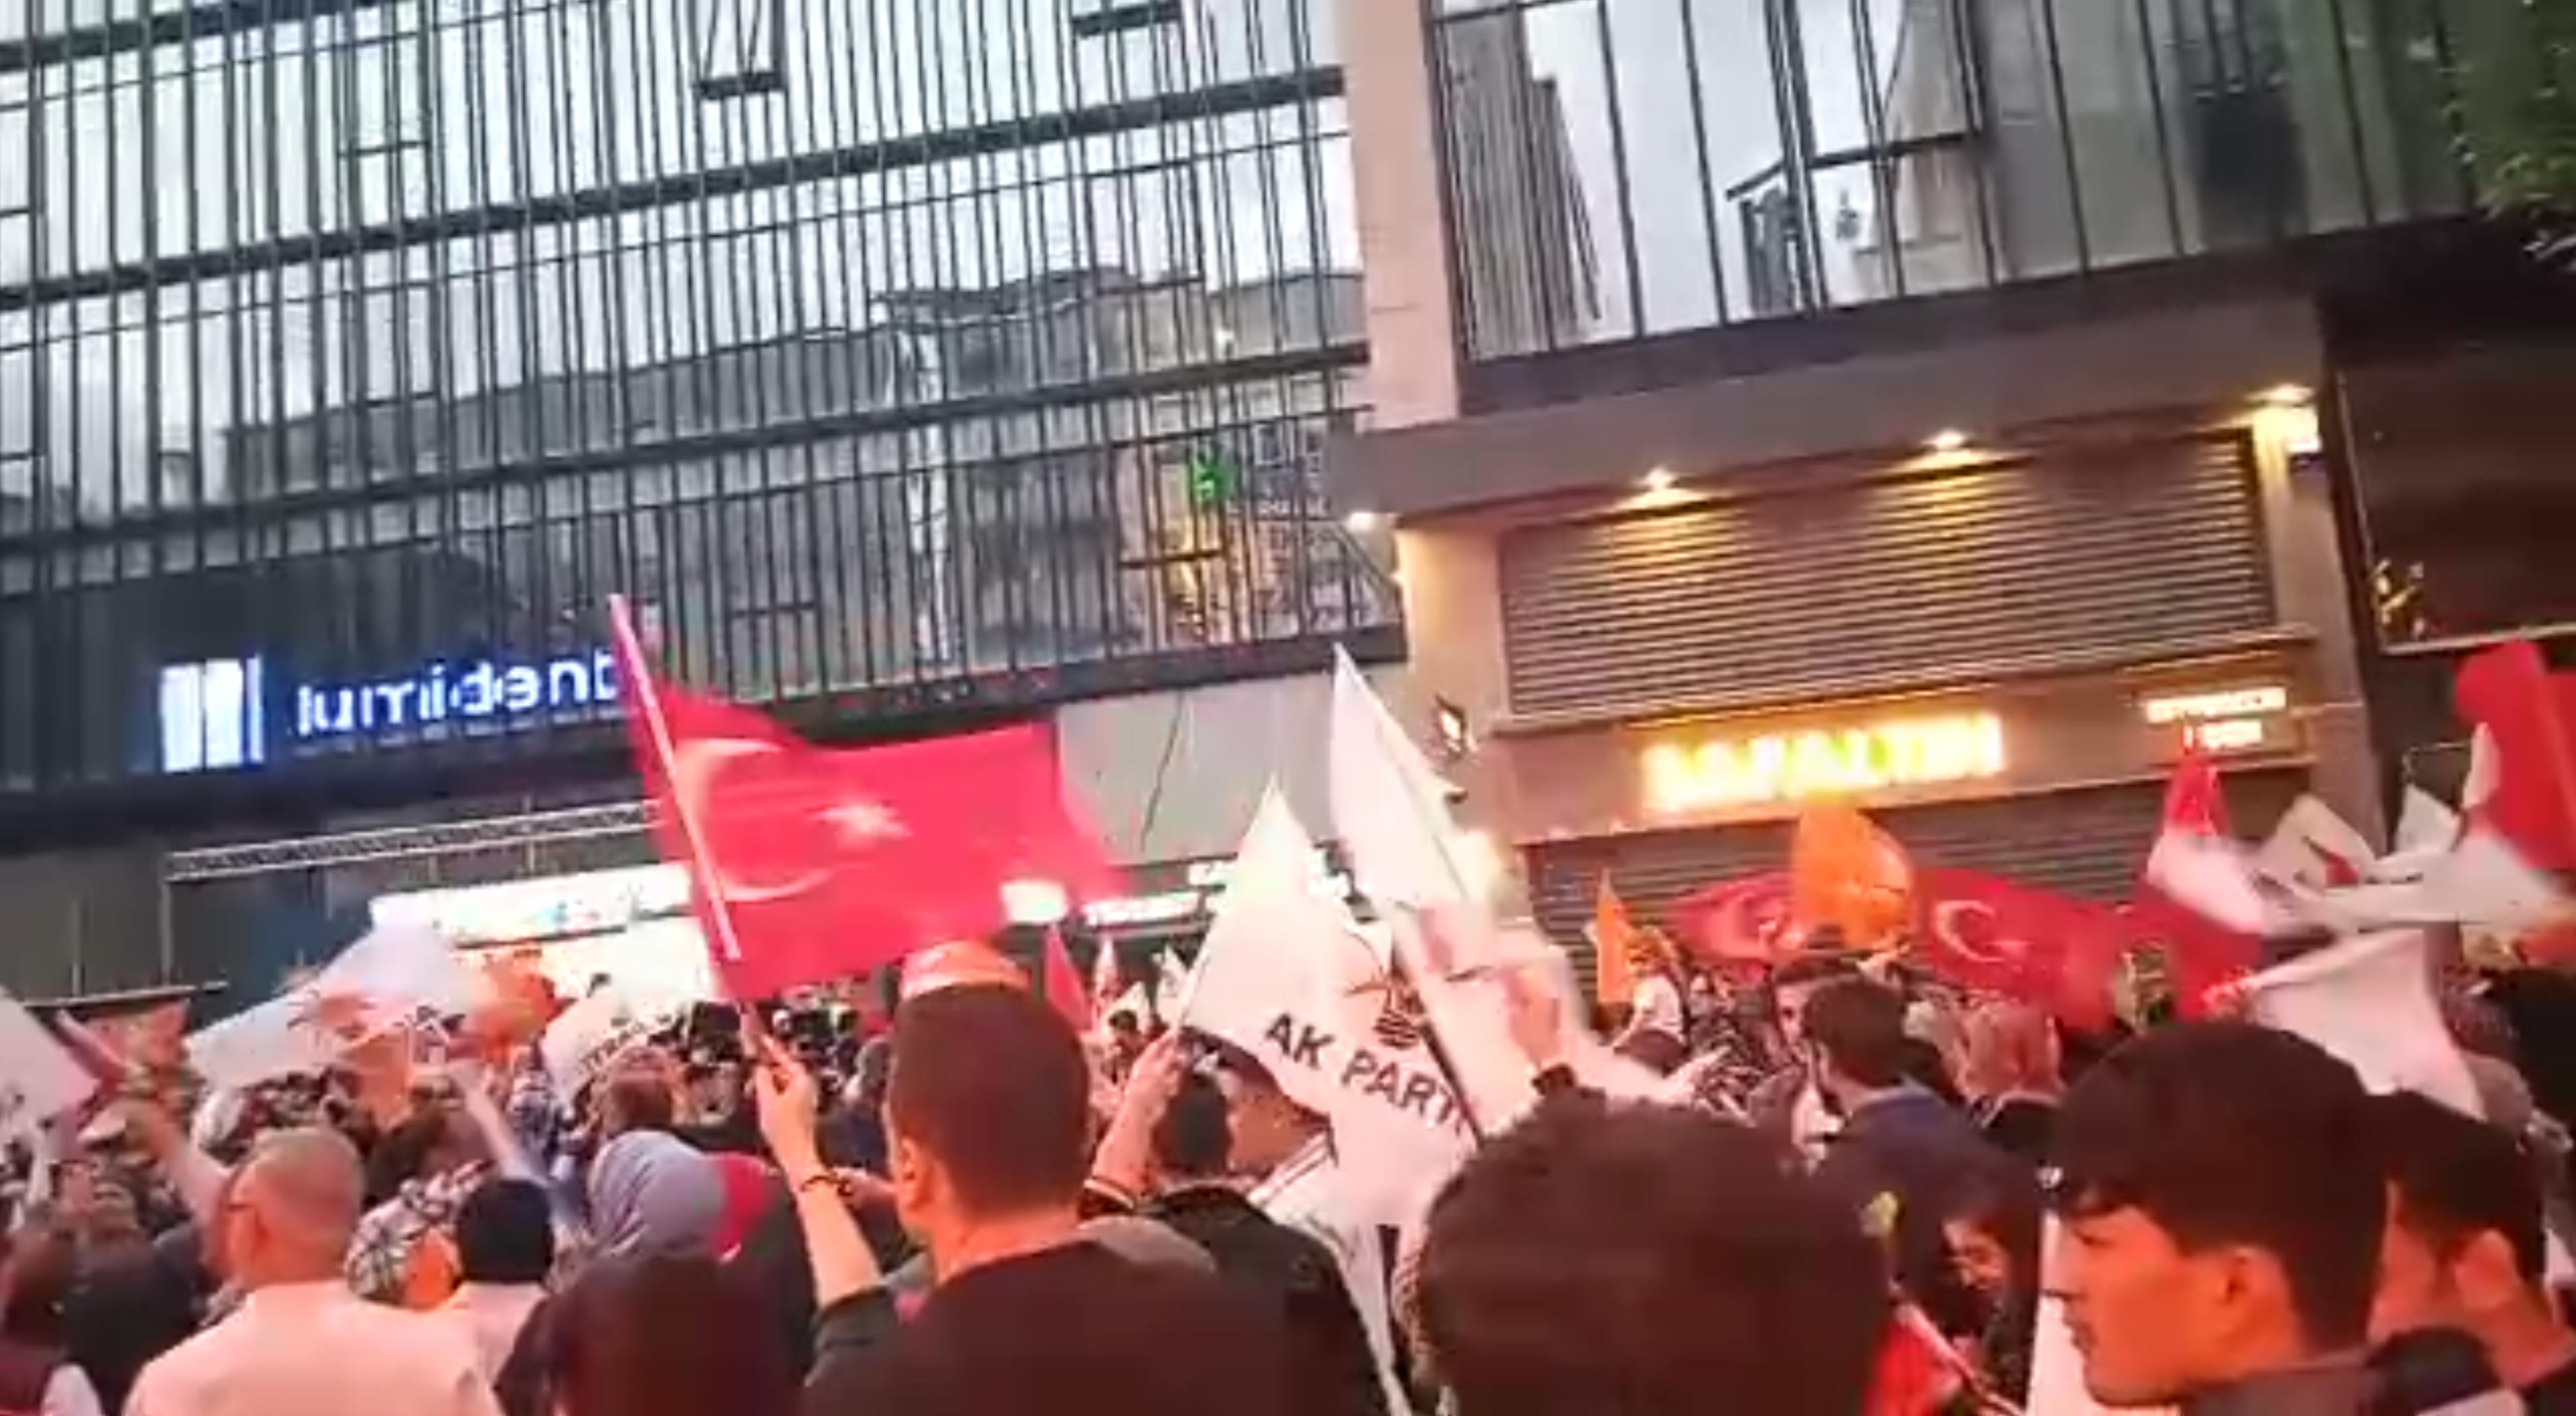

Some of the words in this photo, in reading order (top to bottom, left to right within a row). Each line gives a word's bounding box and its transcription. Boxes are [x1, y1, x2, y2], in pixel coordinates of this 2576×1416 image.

[297, 648, 618, 736] lumident
[1264, 1012, 1334, 1069] AK
[1341, 1048, 1462, 1135] PART
